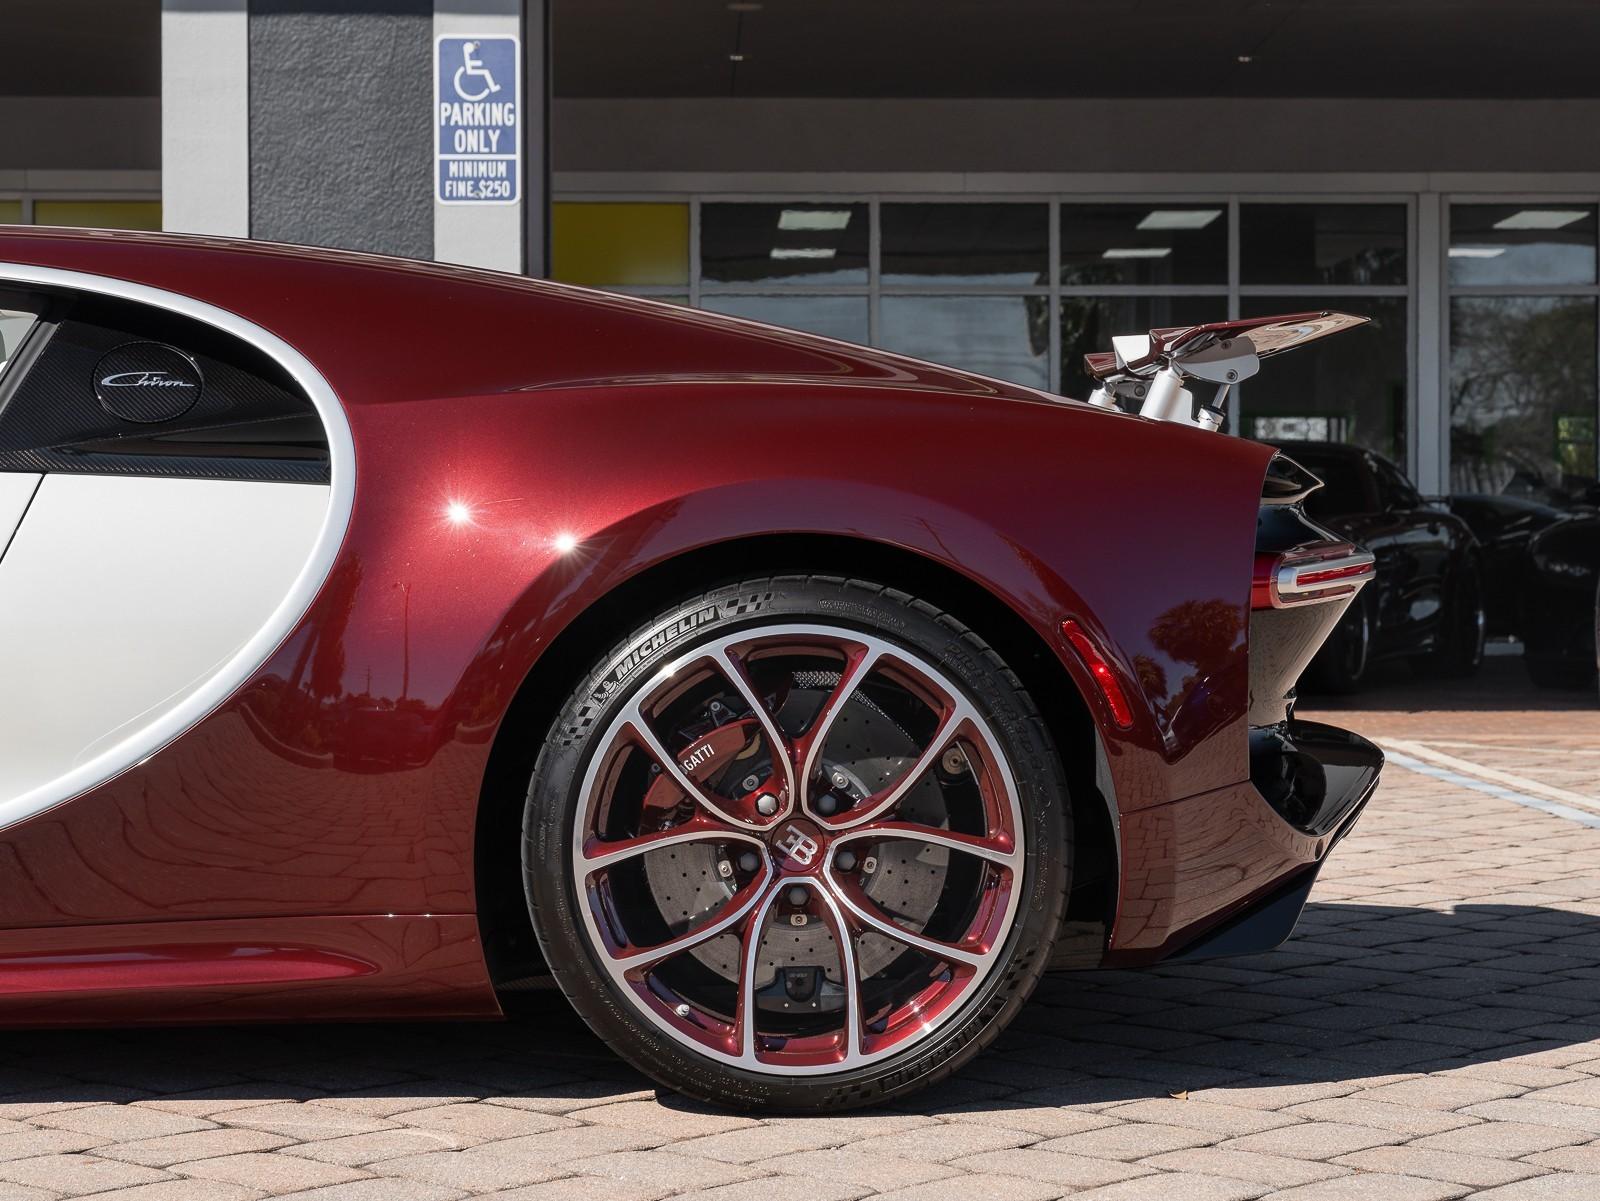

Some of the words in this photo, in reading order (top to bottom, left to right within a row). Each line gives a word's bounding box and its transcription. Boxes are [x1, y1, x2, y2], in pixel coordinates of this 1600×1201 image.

[440, 102, 515, 127] PARKING
[454, 129, 501, 153] ONLY
[449, 161, 507, 178] MINIMUM
[445, 180, 475, 198] FINE
[479, 179, 511, 199] $250
[614, 606, 716, 681] MICHELIN
